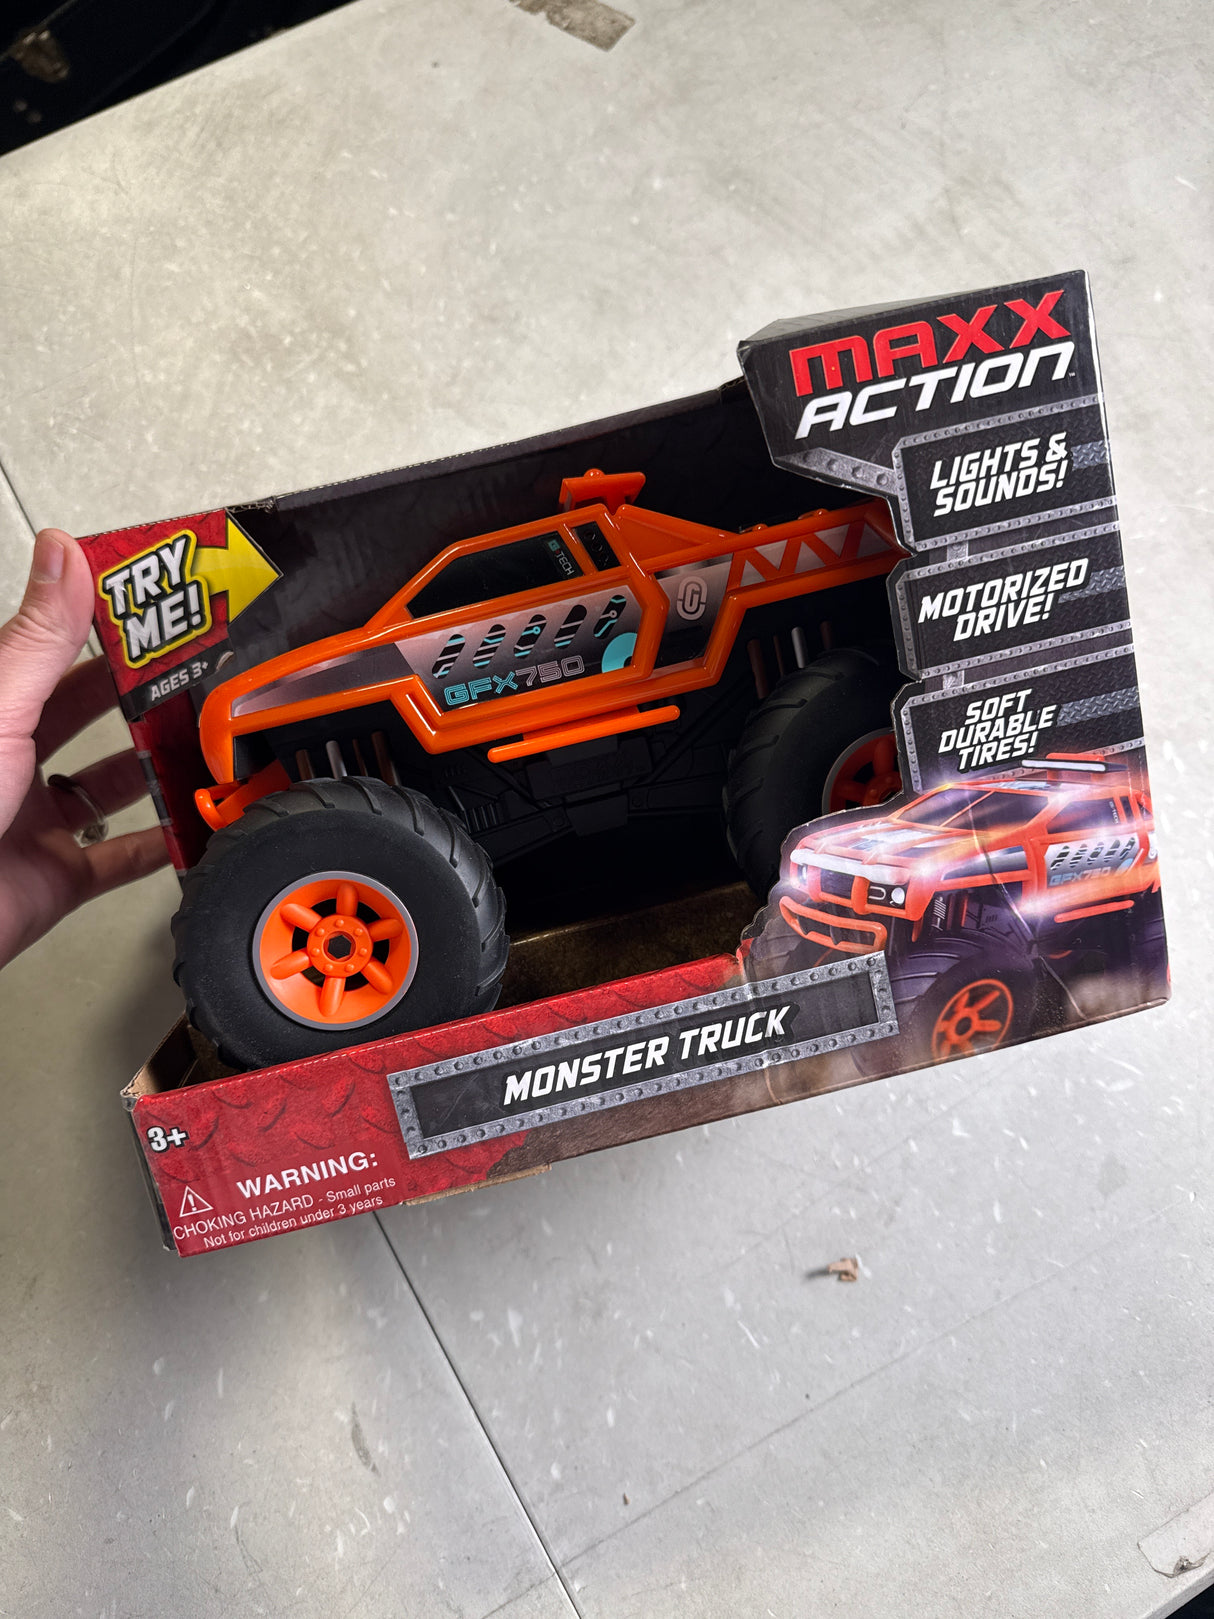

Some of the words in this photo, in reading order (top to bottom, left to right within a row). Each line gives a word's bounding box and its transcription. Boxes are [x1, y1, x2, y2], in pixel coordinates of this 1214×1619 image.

[789, 290, 1072, 397] MAXX
[795, 341, 1075, 440] ACTION
[930, 438, 1038, 489] LIGHTS
[1046, 431, 1068, 461] &
[933, 460, 1068, 517] SOUNDS!
[105, 538, 186, 616] TRY
[917, 557, 1088, 623] MOTORIZED
[126, 584, 201, 659] ME!
[953, 593, 1055, 642] DRIVE!
[151, 669, 188, 701] AGES
[193, 661, 209, 678] 3+
[964, 689, 1032, 725] SOFT
[938, 705, 1057, 753] DURABLE
[958, 732, 1038, 770] TIRES!
[503, 1035, 669, 1106] MONSTER
[678, 1006, 790, 1060] TRUCK
[147, 1126, 188, 1151] 3+
[236, 1152, 378, 1198] WARNING:
[173, 1211, 246, 1240] CHOKING
[249, 1195, 313, 1220] HAZARD
[326, 1184, 361, 1203] Small
[364, 1178, 396, 1195] parts
[203, 1234, 227, 1248] Not
[229, 1230, 245, 1242] for
[249, 1219, 297, 1237] children
[300, 1208, 334, 1224] under
[338, 1204, 346, 1215] 3
[350, 1196, 383, 1214] years
